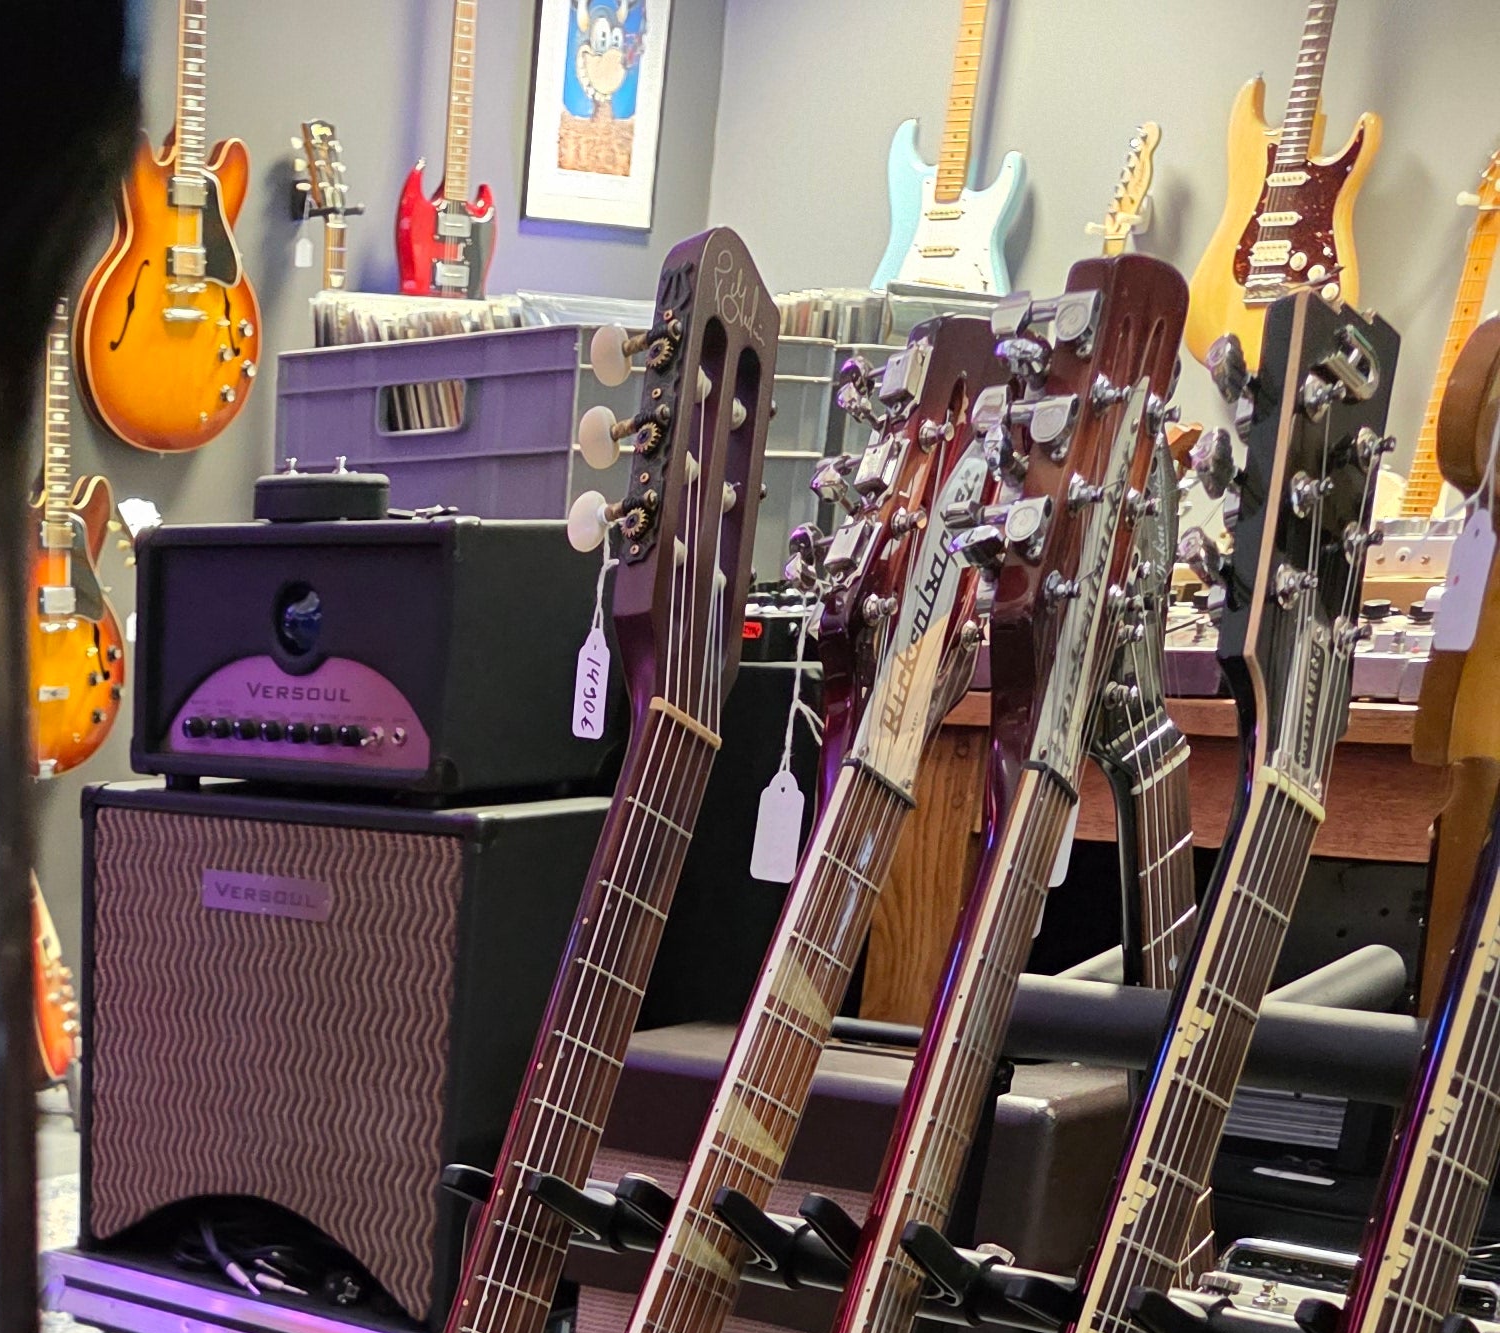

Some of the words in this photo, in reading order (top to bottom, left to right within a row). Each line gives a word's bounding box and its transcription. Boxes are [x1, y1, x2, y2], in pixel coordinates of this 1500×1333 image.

[883, 472, 979, 744] Rickenbacer
[247, 682, 350, 702] VERSOUL
[215, 881, 317, 908] VERSOUL
